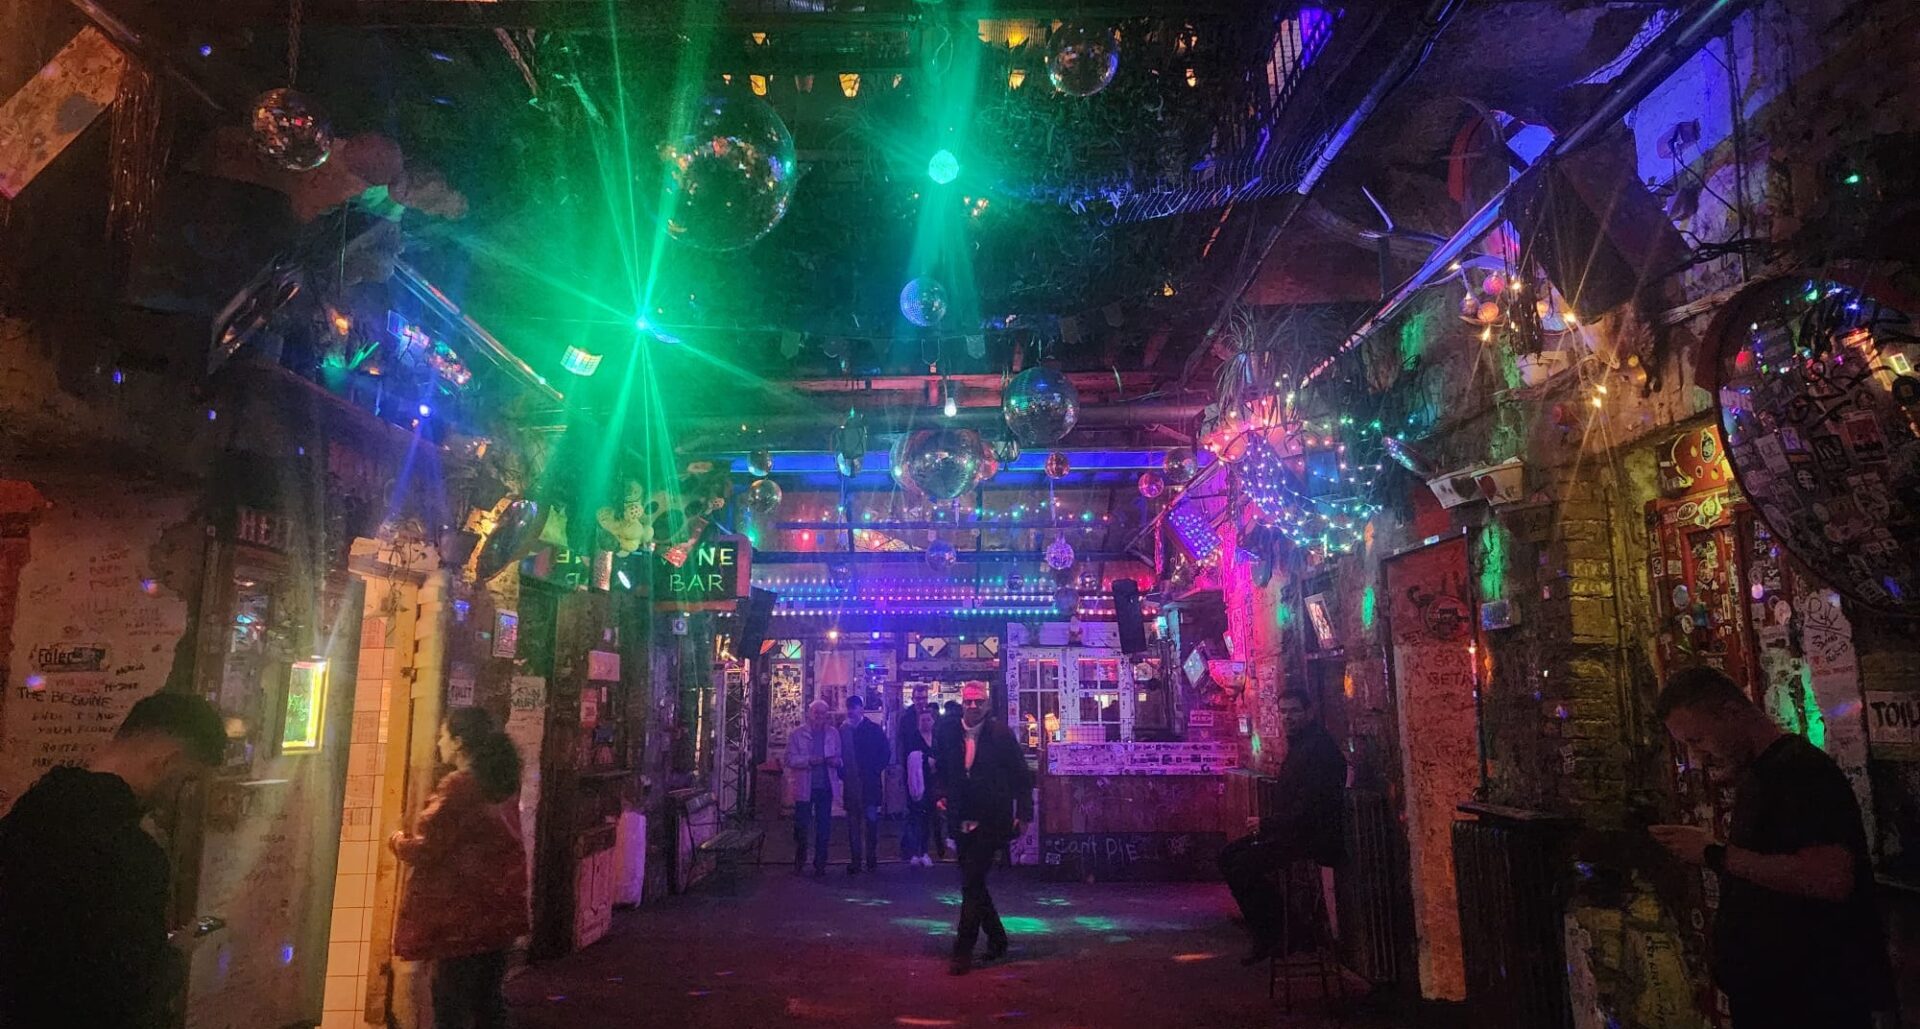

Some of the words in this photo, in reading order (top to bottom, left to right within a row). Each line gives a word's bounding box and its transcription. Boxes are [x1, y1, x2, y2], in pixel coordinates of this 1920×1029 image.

[669, 573, 724, 592] BAR
[17, 686, 46, 702] THE
[1870, 701, 1920, 728] TOIL
[1105, 837, 1137, 864] DIE
